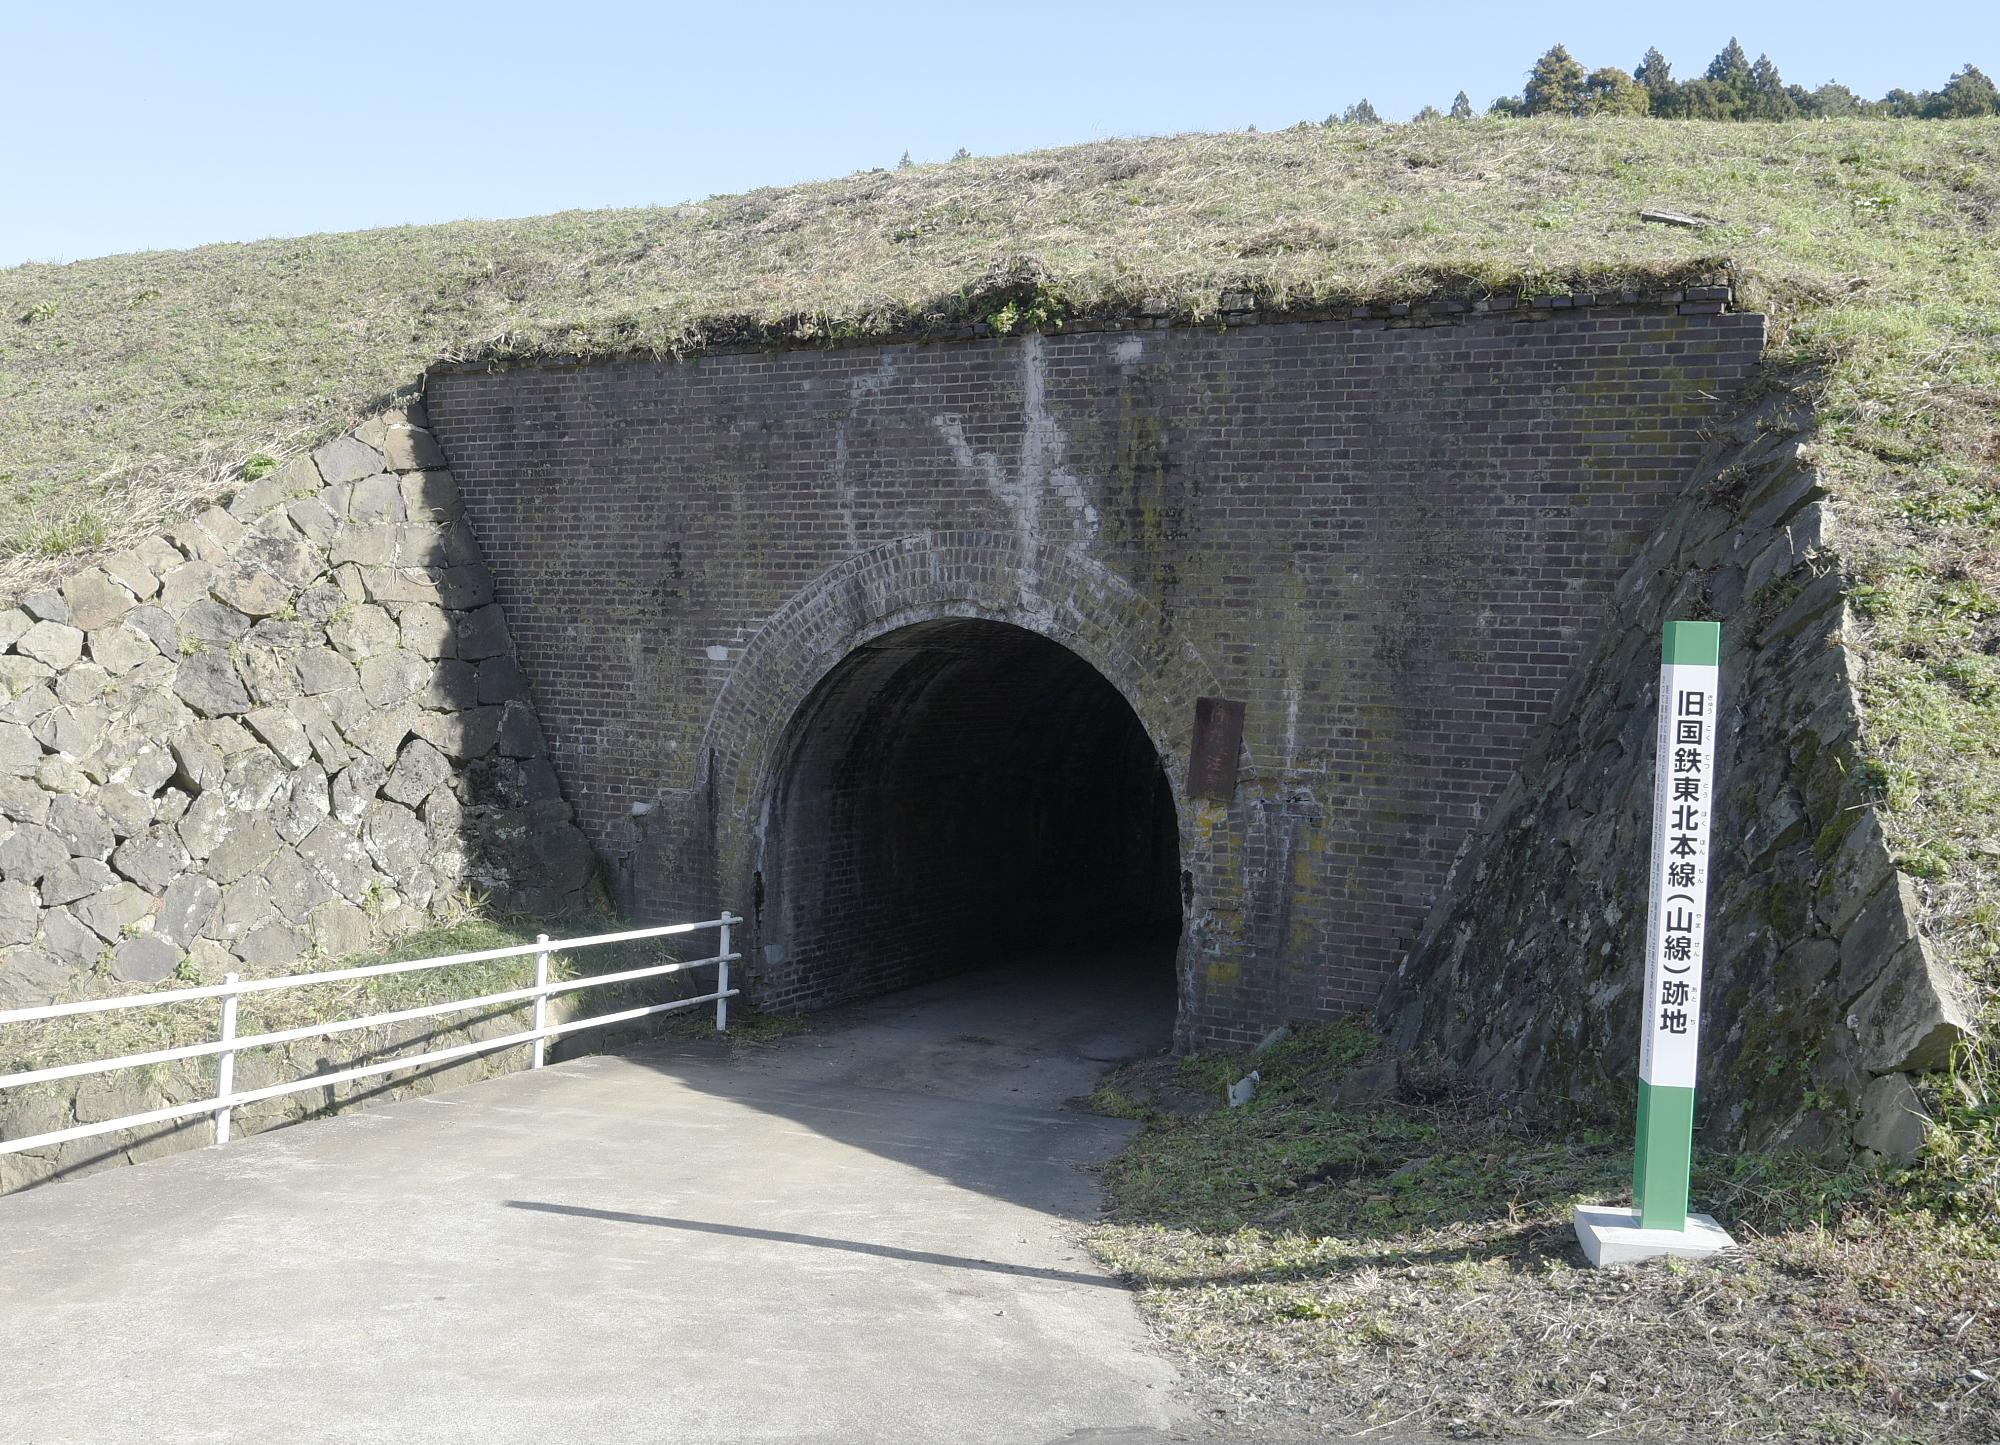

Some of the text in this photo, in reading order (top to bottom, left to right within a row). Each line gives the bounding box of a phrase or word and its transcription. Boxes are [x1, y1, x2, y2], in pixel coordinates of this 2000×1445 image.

[1660, 690, 1705, 1034] 旧国鉄東北本線(山線)跡地
